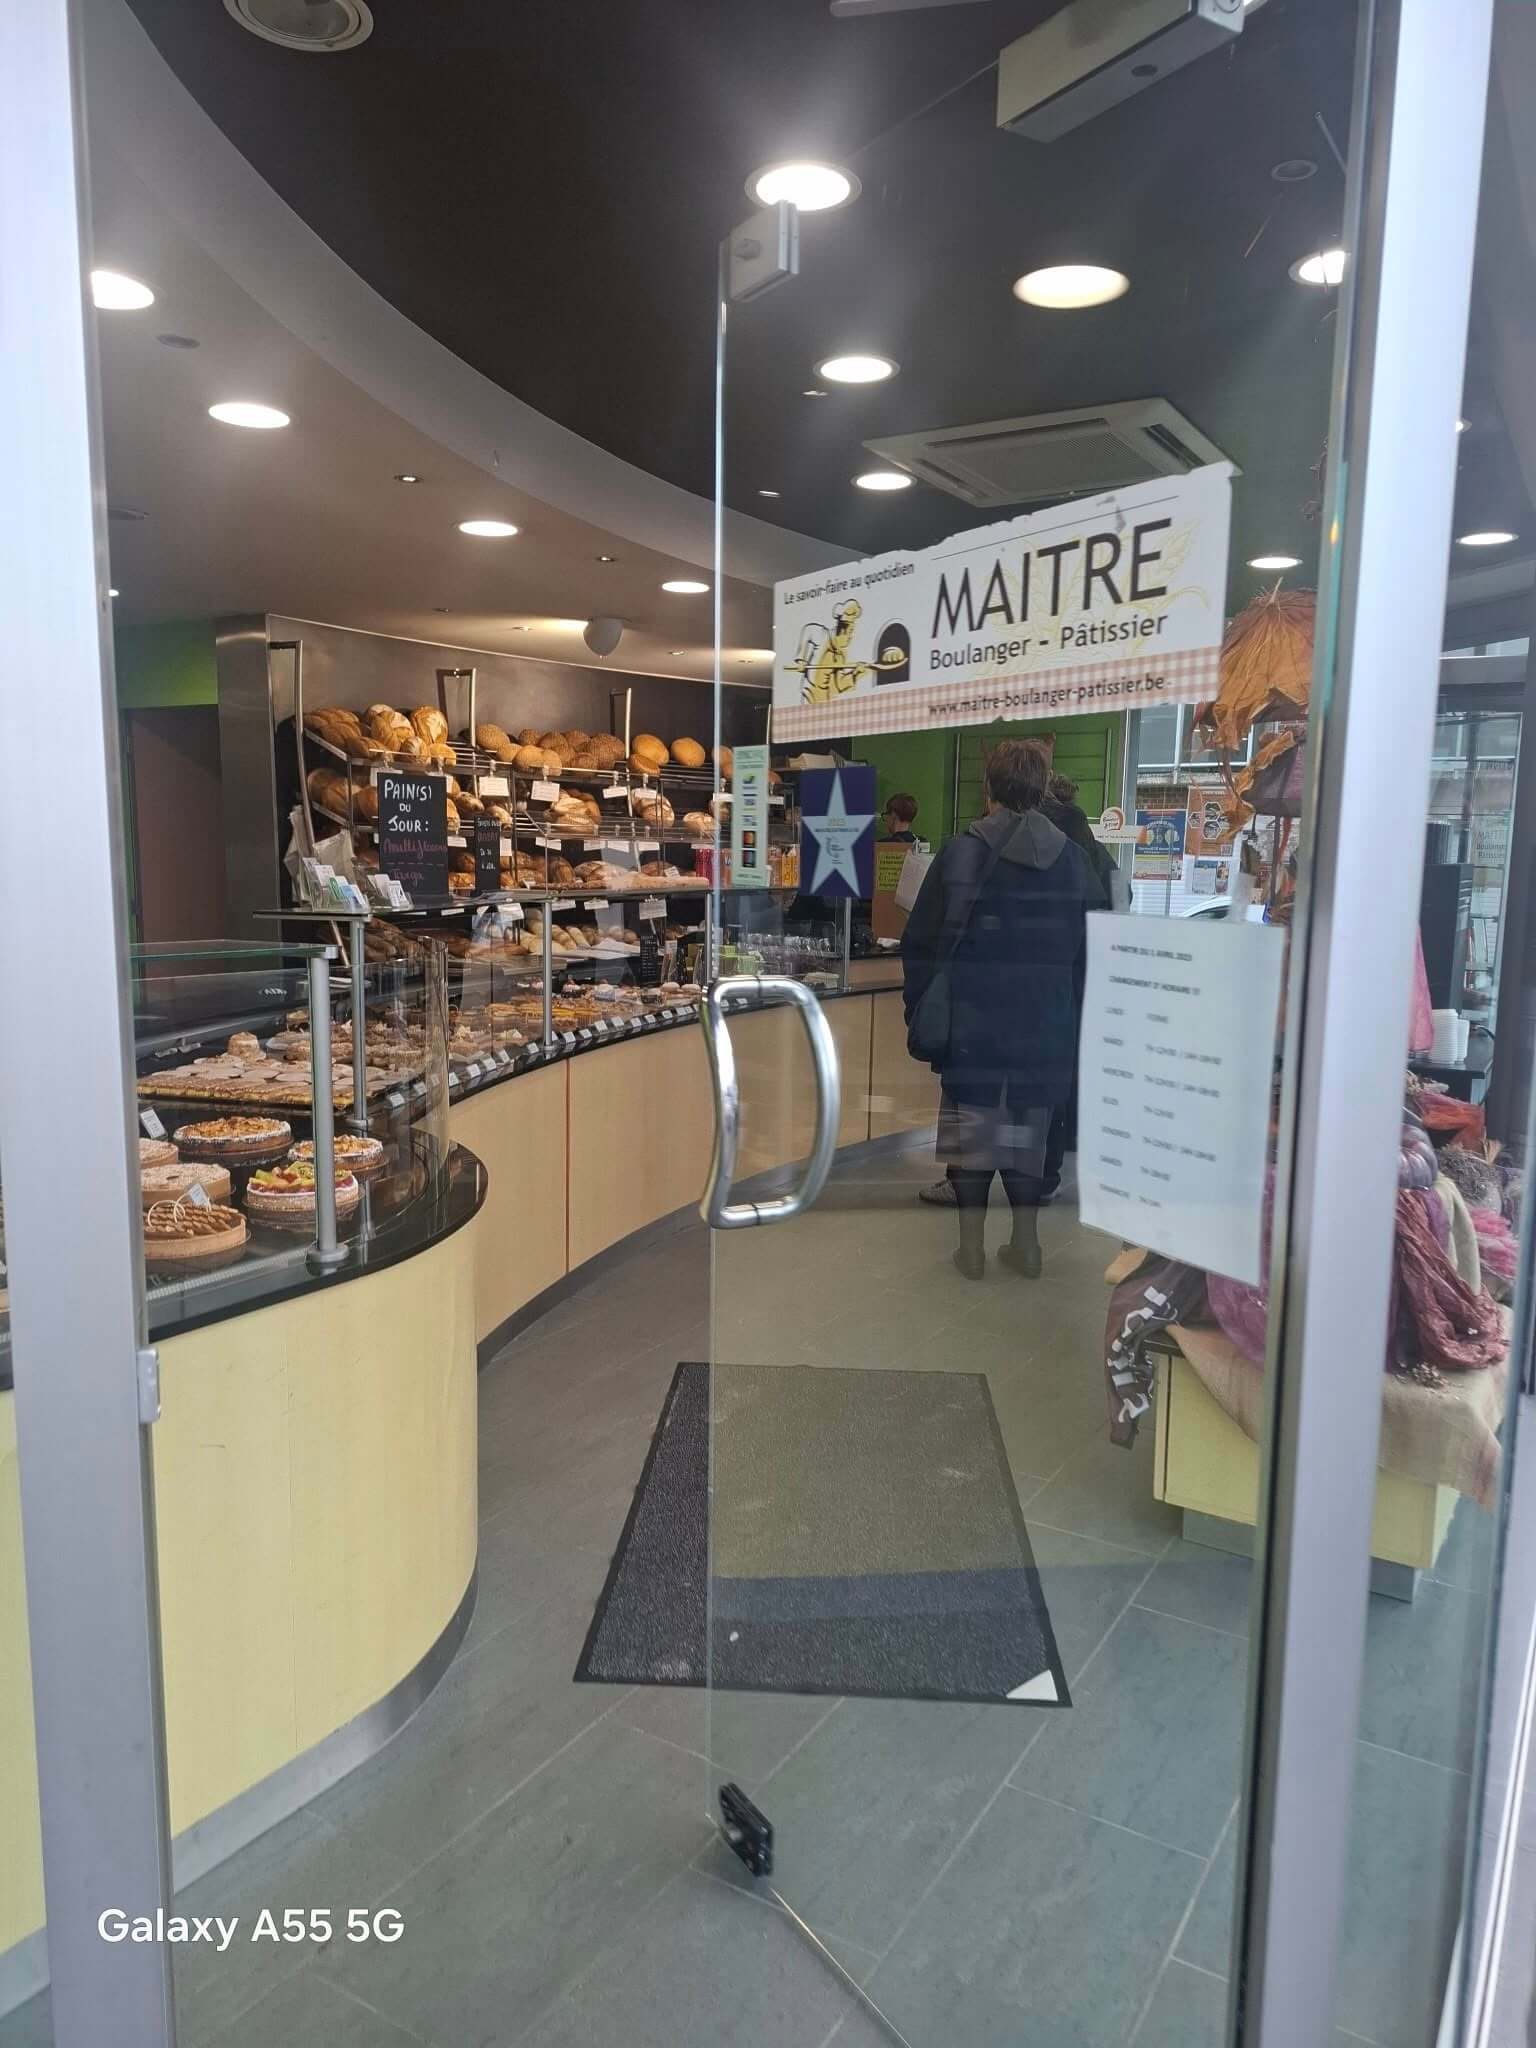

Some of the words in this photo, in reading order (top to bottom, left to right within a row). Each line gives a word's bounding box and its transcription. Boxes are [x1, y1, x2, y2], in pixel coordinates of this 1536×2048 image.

[783, 592, 795, 605] Le
[796, 579, 848, 602] savoir-faire
[850, 577, 862, 589] au
[863, 561, 914, 589] quotidien
[932, 517, 1173, 639] MAITRE
[929, 637, 1032, 670] Boulanger
[1060, 613, 1169, 649] Pâtissier
[927, 672, 1165, 716] www.maitre-boulanger-patissier.be
[384, 778, 432, 801] PAIN(S)
[399, 802, 411, 813] DU
